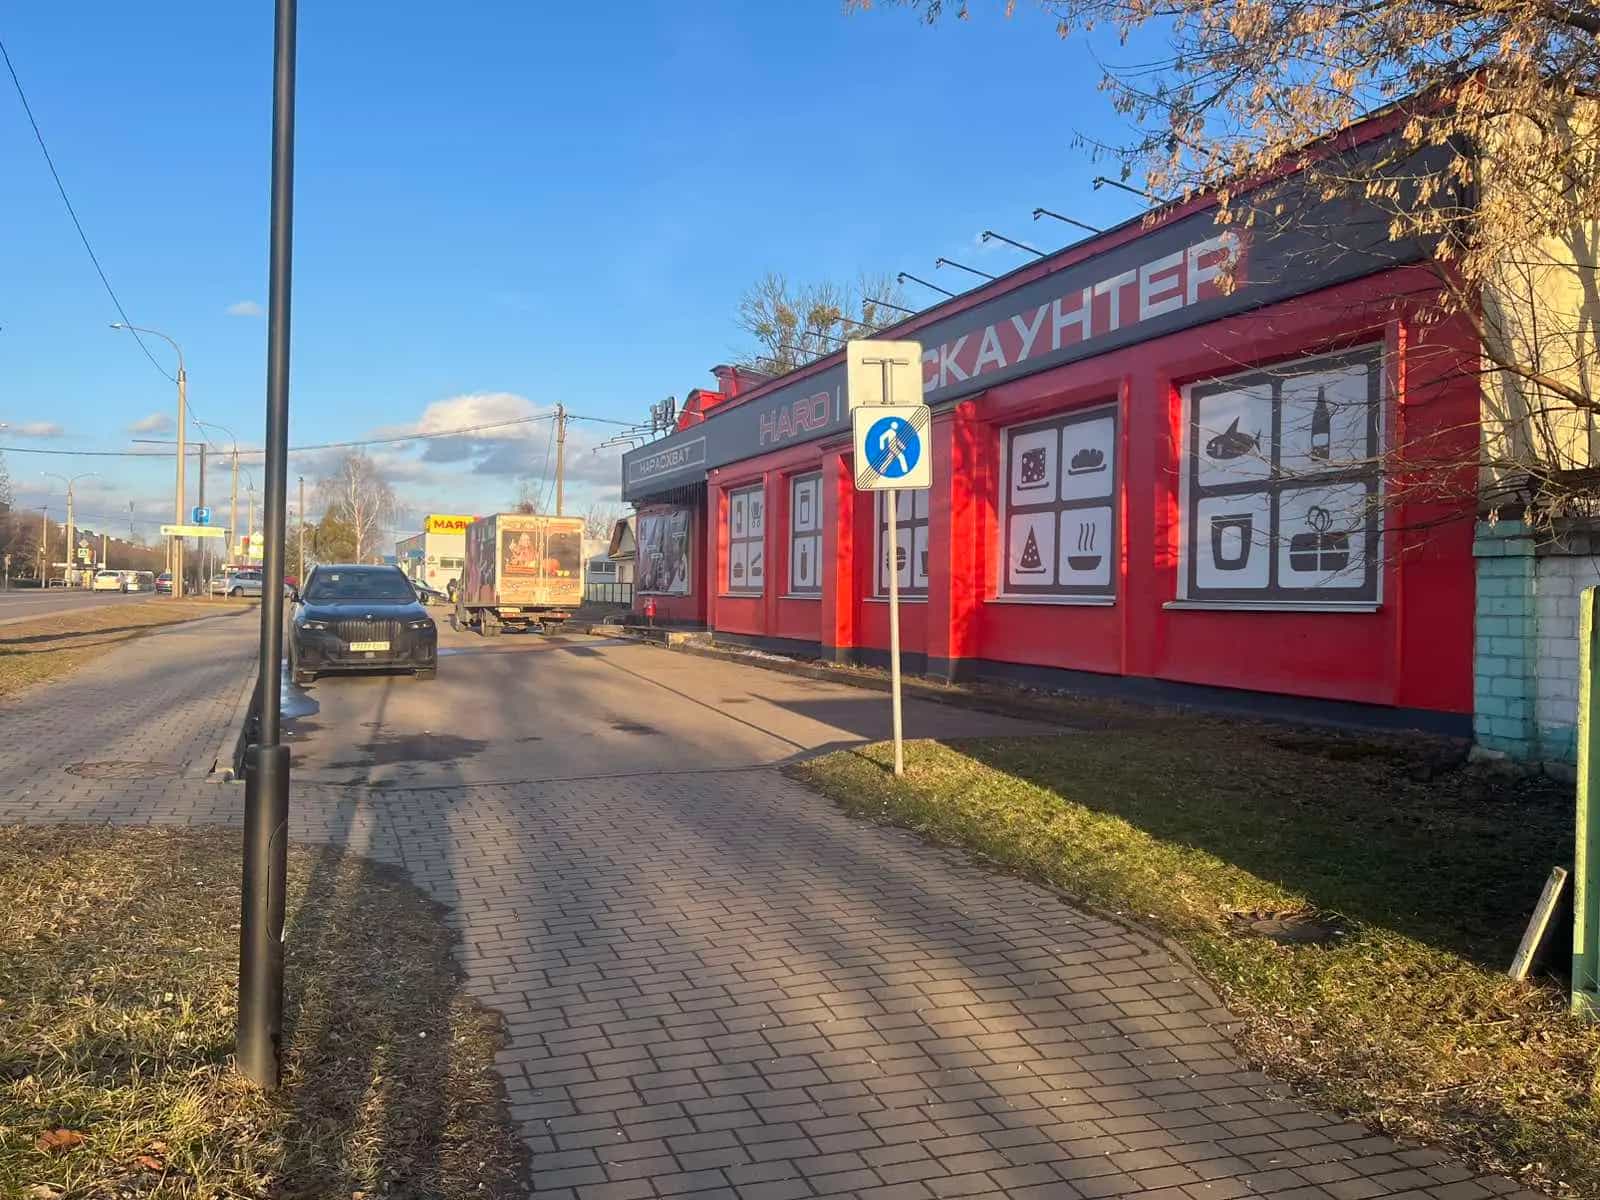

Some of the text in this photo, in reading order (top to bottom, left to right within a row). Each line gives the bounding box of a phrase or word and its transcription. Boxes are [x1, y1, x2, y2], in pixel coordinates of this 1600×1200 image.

[922, 232, 1241, 393] СКАУНТЕР
[759, 391, 831, 446] HARD
[197, 509, 207, 523] P
